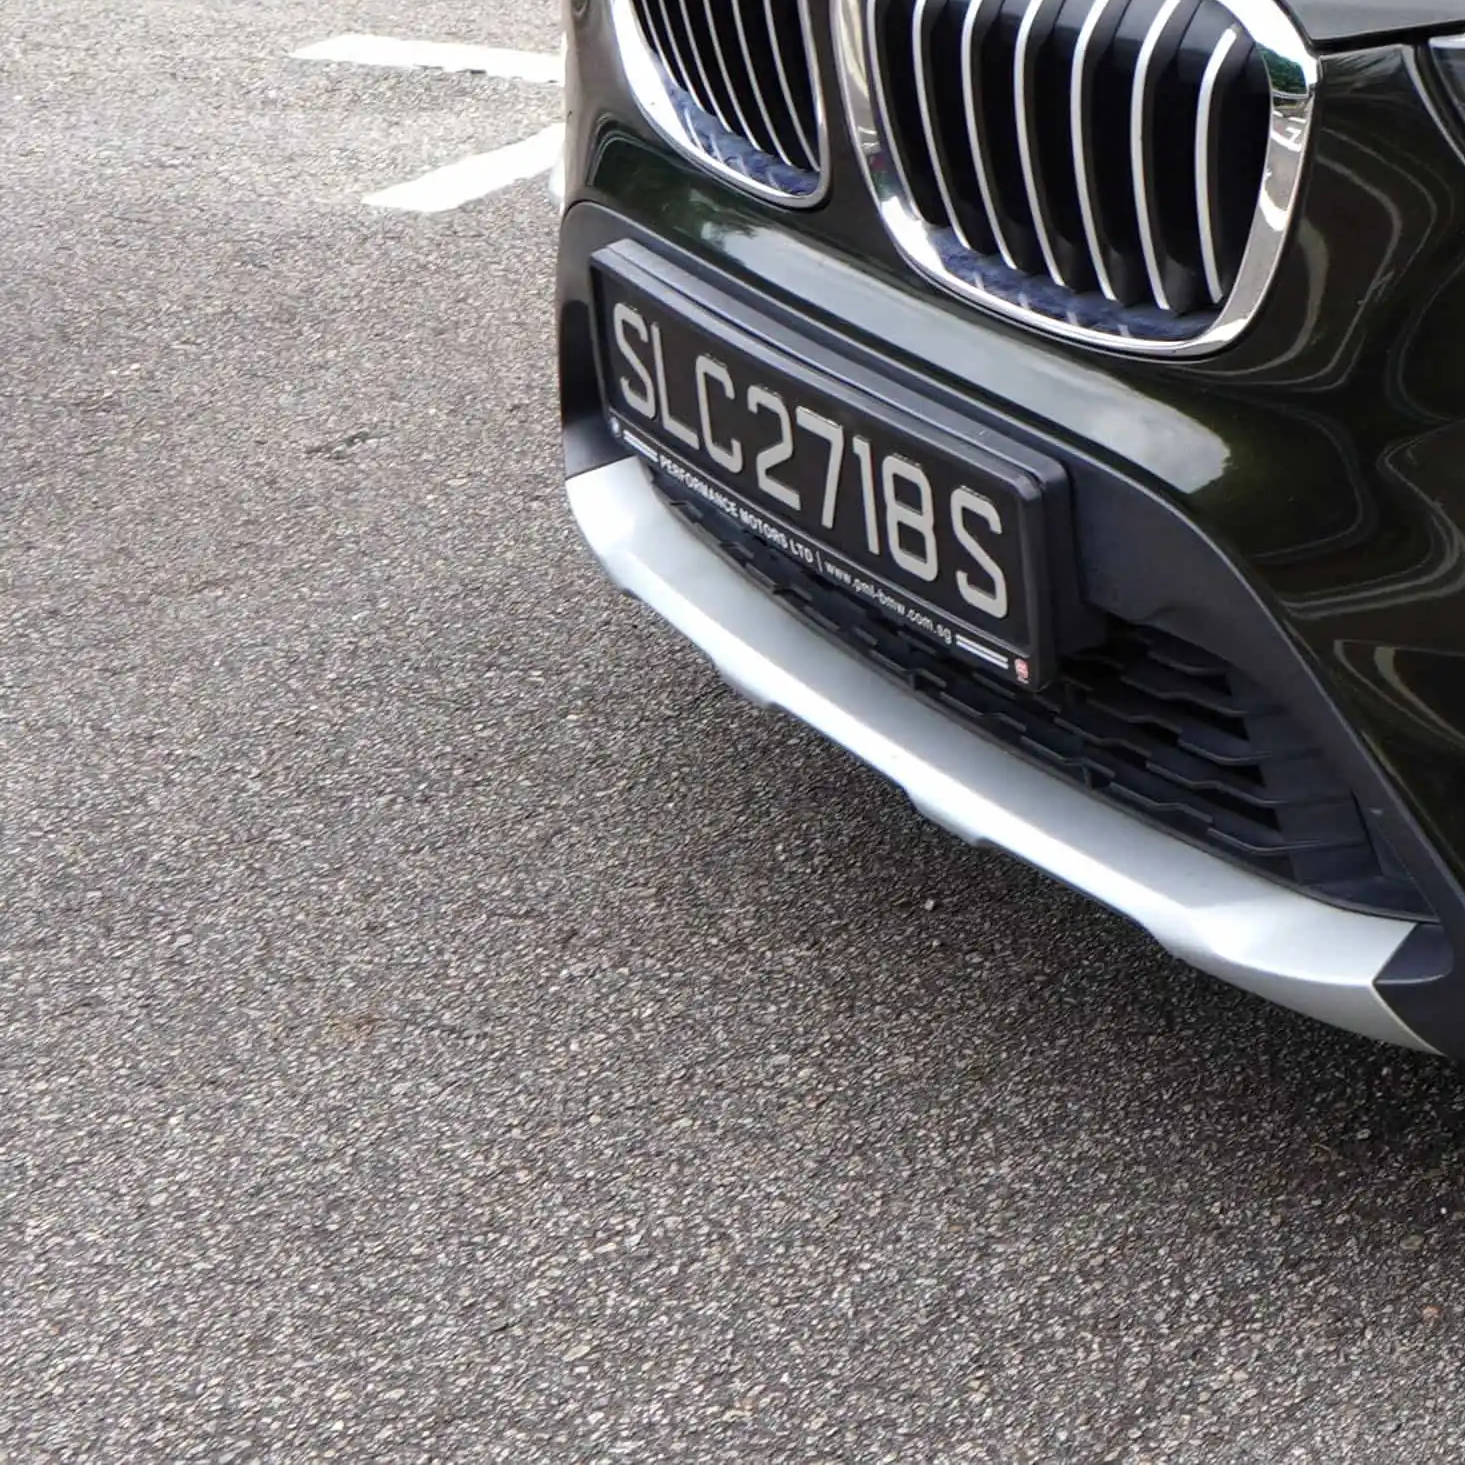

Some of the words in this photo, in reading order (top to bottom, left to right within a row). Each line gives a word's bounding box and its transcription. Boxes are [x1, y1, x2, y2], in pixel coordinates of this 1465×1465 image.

[612, 301, 1009, 619] SLC2718S
[659, 454, 738, 518] PERFORMANCE
[739, 507, 788, 549] MOTORS
[789, 538, 814, 564] LTD
